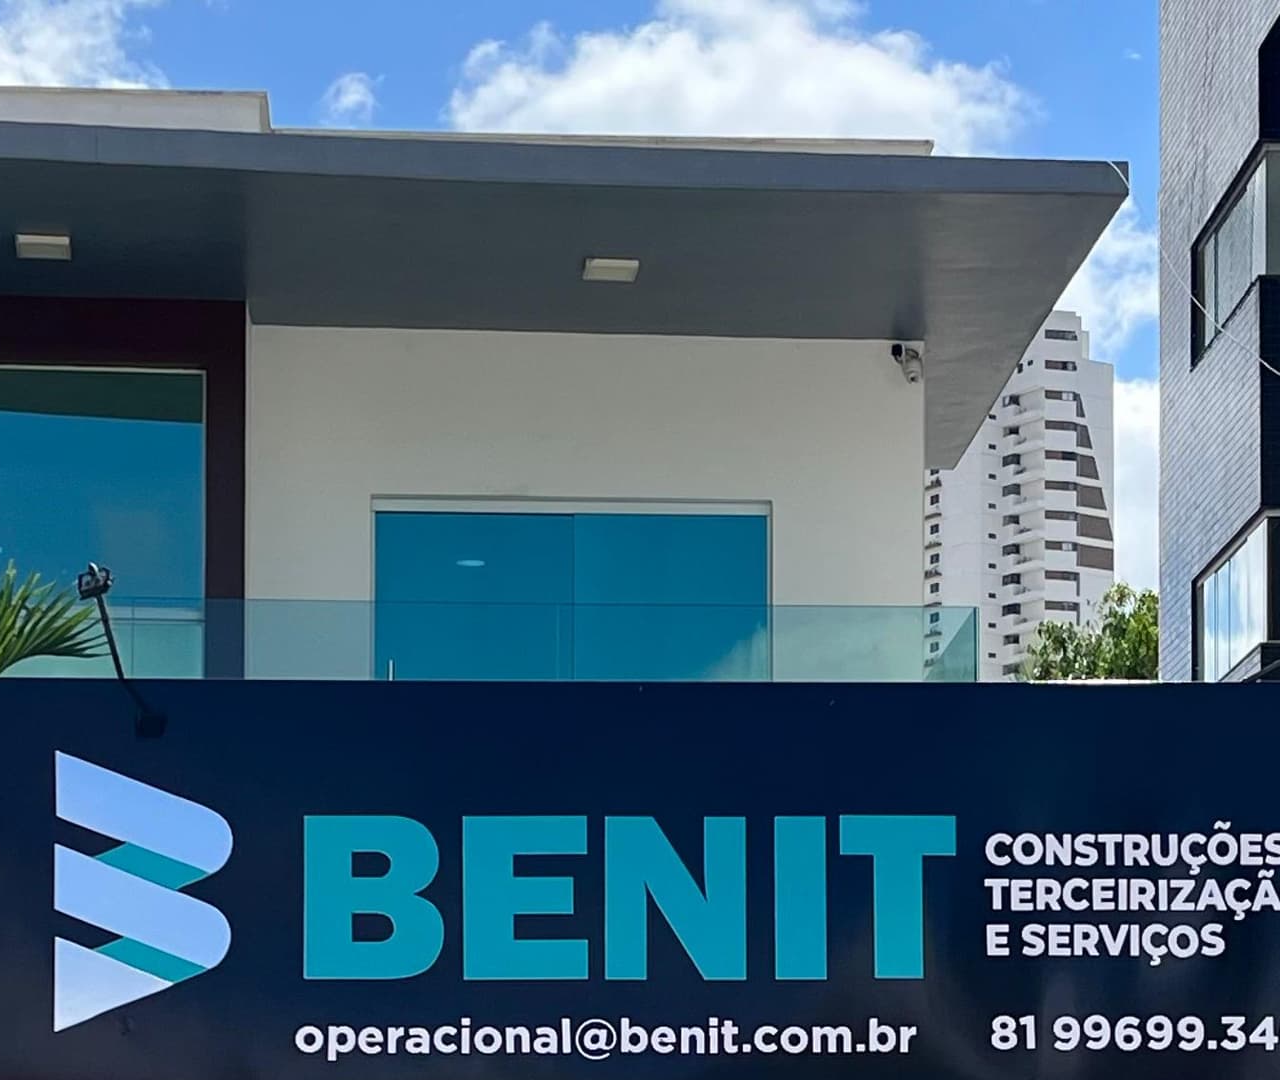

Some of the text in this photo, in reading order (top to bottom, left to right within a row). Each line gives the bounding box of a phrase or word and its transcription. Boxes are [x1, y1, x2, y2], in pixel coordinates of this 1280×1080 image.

[303, 815, 958, 981] BENIT
[986, 923, 1226, 967] E SERVIÇOS
[294, 1018, 918, 1062] operacional@benit.com.br
[991, 1016, 1037, 1051] 81
